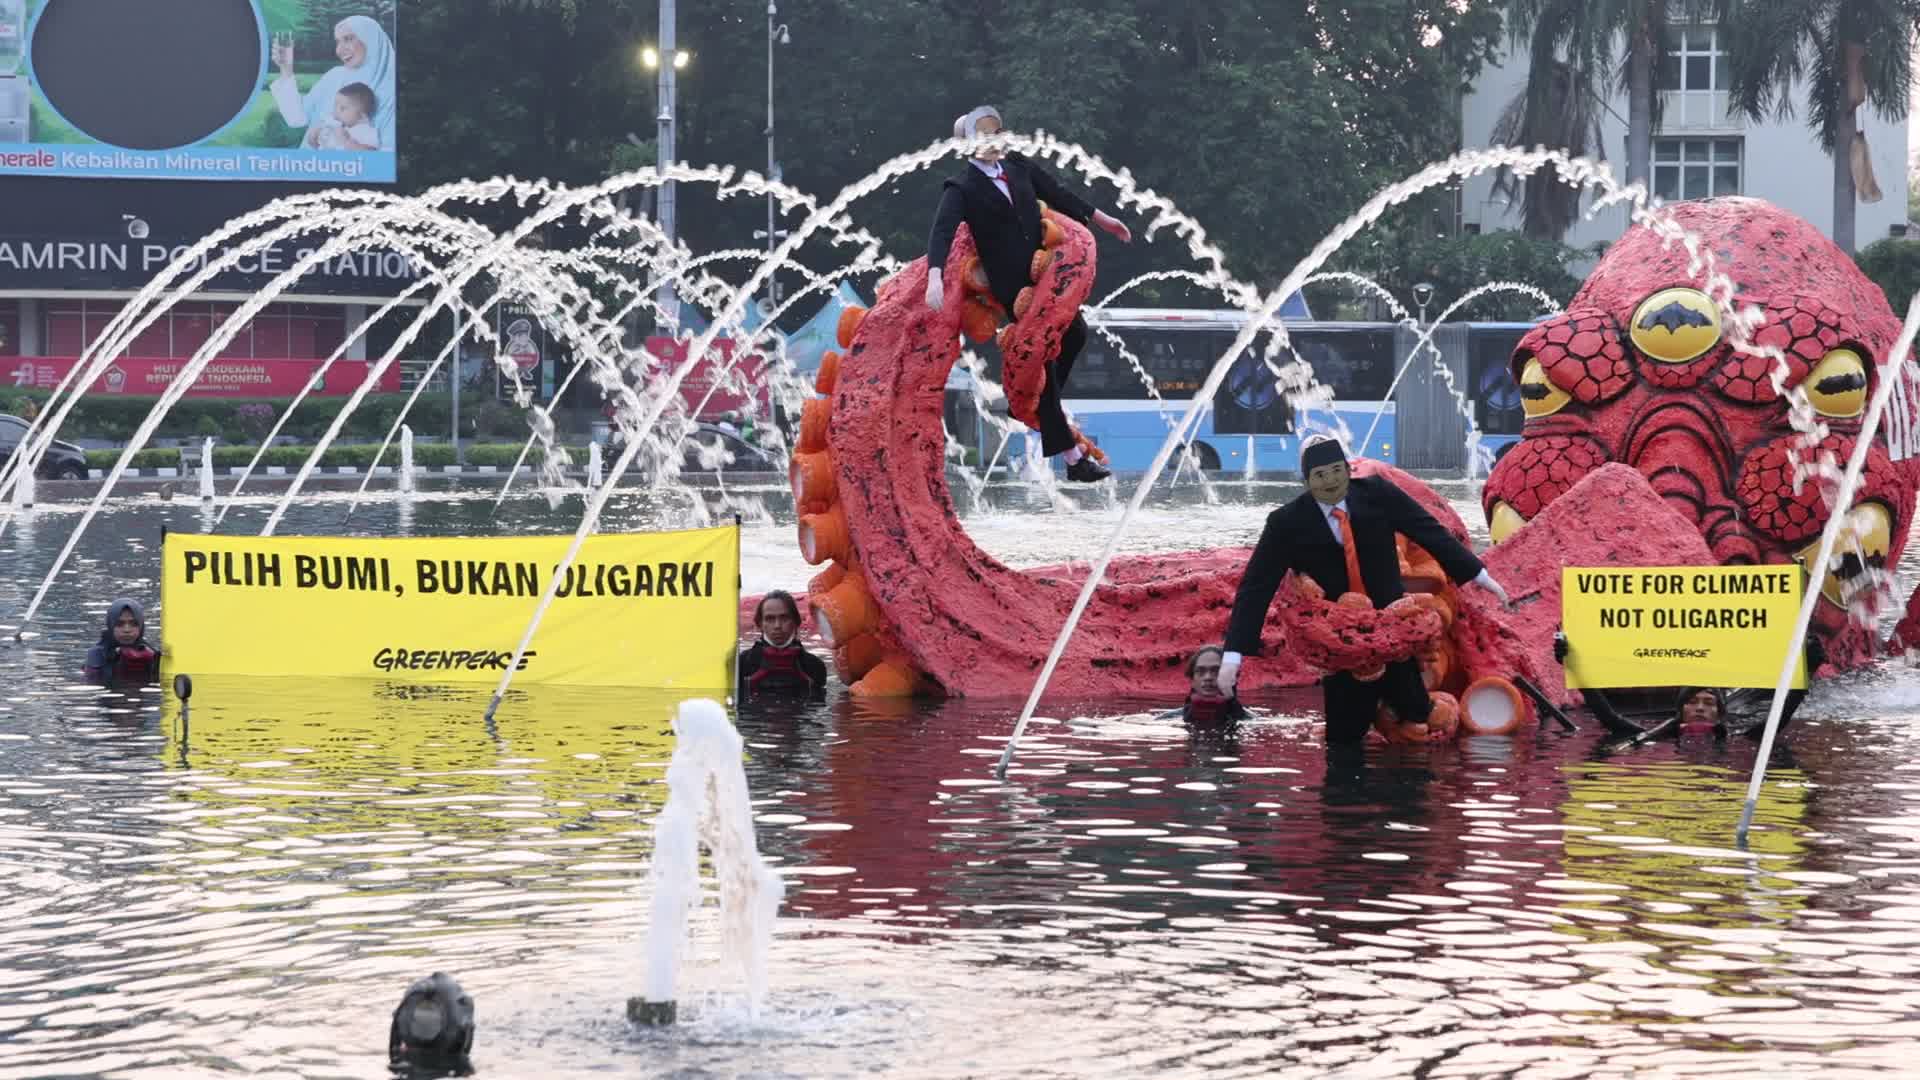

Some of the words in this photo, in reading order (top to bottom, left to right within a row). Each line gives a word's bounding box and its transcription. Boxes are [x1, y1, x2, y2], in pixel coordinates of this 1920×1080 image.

[165, 153, 241, 172] Mineral
[248, 155, 364, 176] Terlindungi
[0, 242, 127, 271] AMRIN
[184, 550, 282, 587] PILIH
[294, 554, 405, 598] BUMI,
[416, 559, 539, 597] BUKAN
[552, 561, 714, 598] OLIGARKI
[1577, 574, 1633, 594] VOTE
[1641, 574, 1684, 594] FOR
[1692, 573, 1791, 594] CLIMATE
[1600, 608, 1644, 628] NOT
[1652, 607, 1767, 629] OLIGARCH
[372, 647, 537, 672] GREENPEACE
[1632, 648, 1711, 658] GREENPEACE
